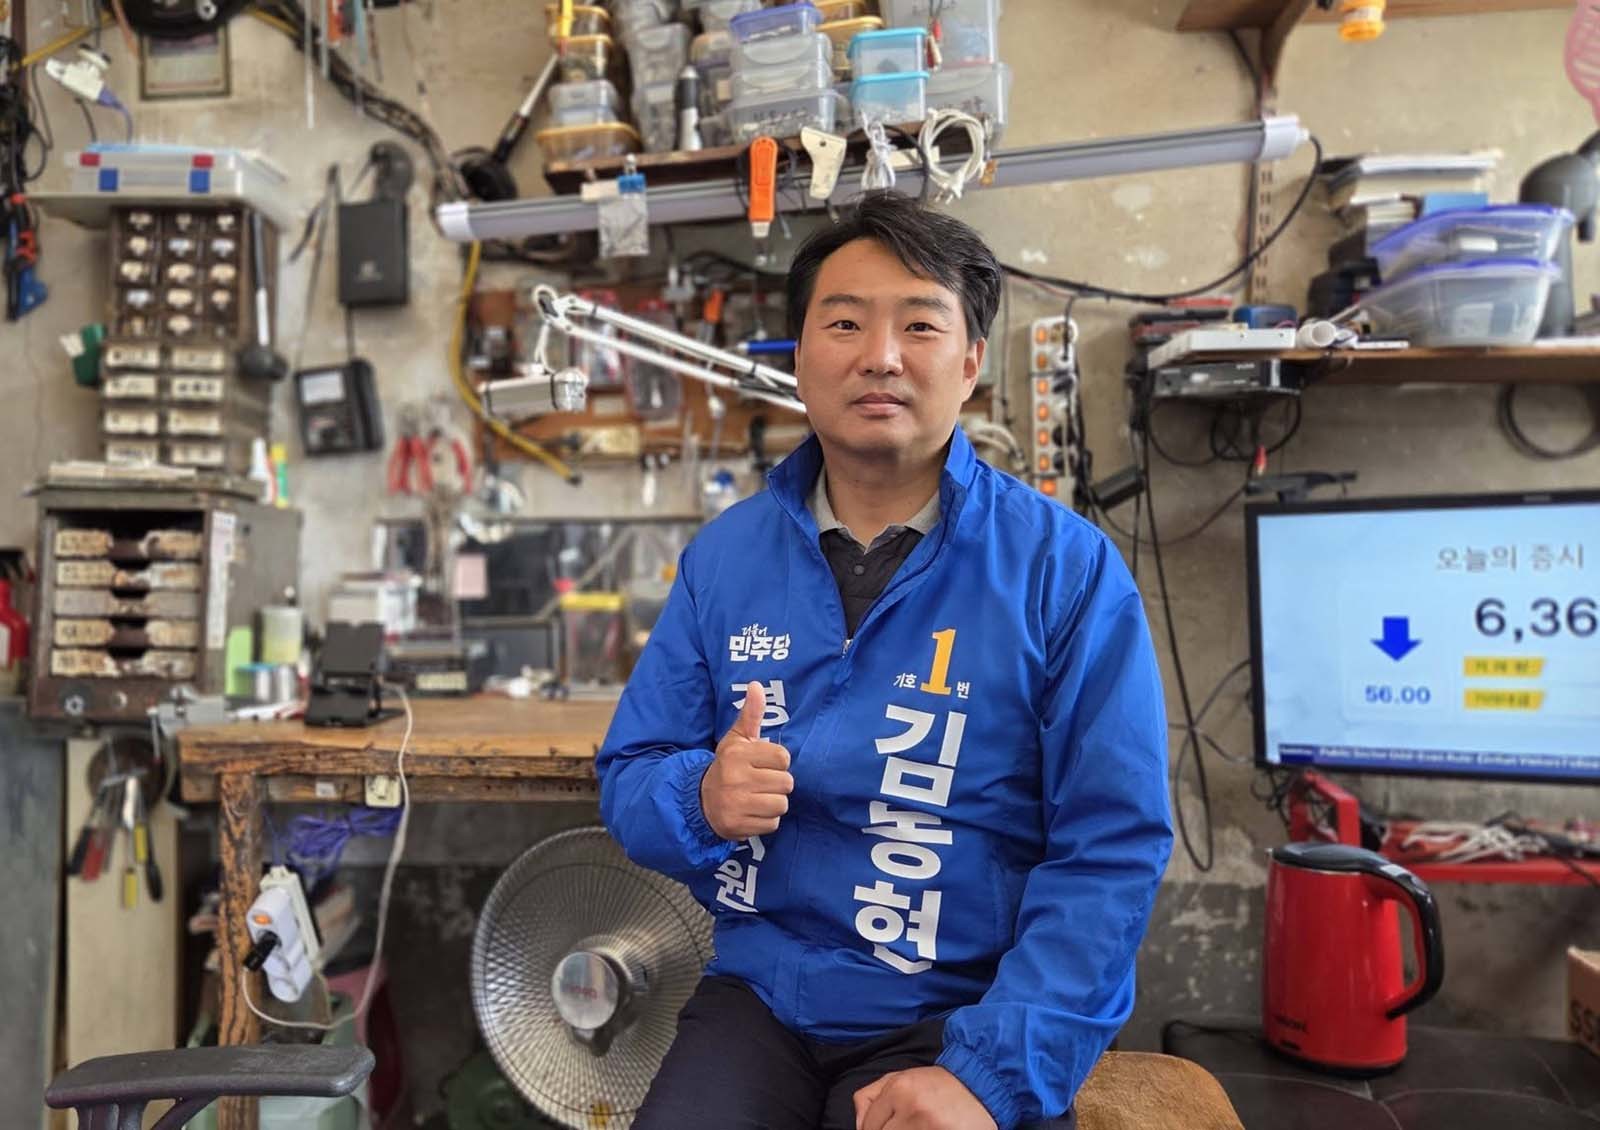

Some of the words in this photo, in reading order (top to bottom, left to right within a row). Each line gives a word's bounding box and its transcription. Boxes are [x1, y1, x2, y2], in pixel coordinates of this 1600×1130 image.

[1437, 545, 1518, 572] 오늘의
[741, 623, 768, 637] 더불어
[1475, 597, 1599, 643] 6,36
[729, 634, 791, 661] 민주당
[893, 672, 917, 689] 기호
[919, 628, 957, 696] 1
[957, 681, 971, 699] 번
[1365, 686, 1431, 705] 56.00
